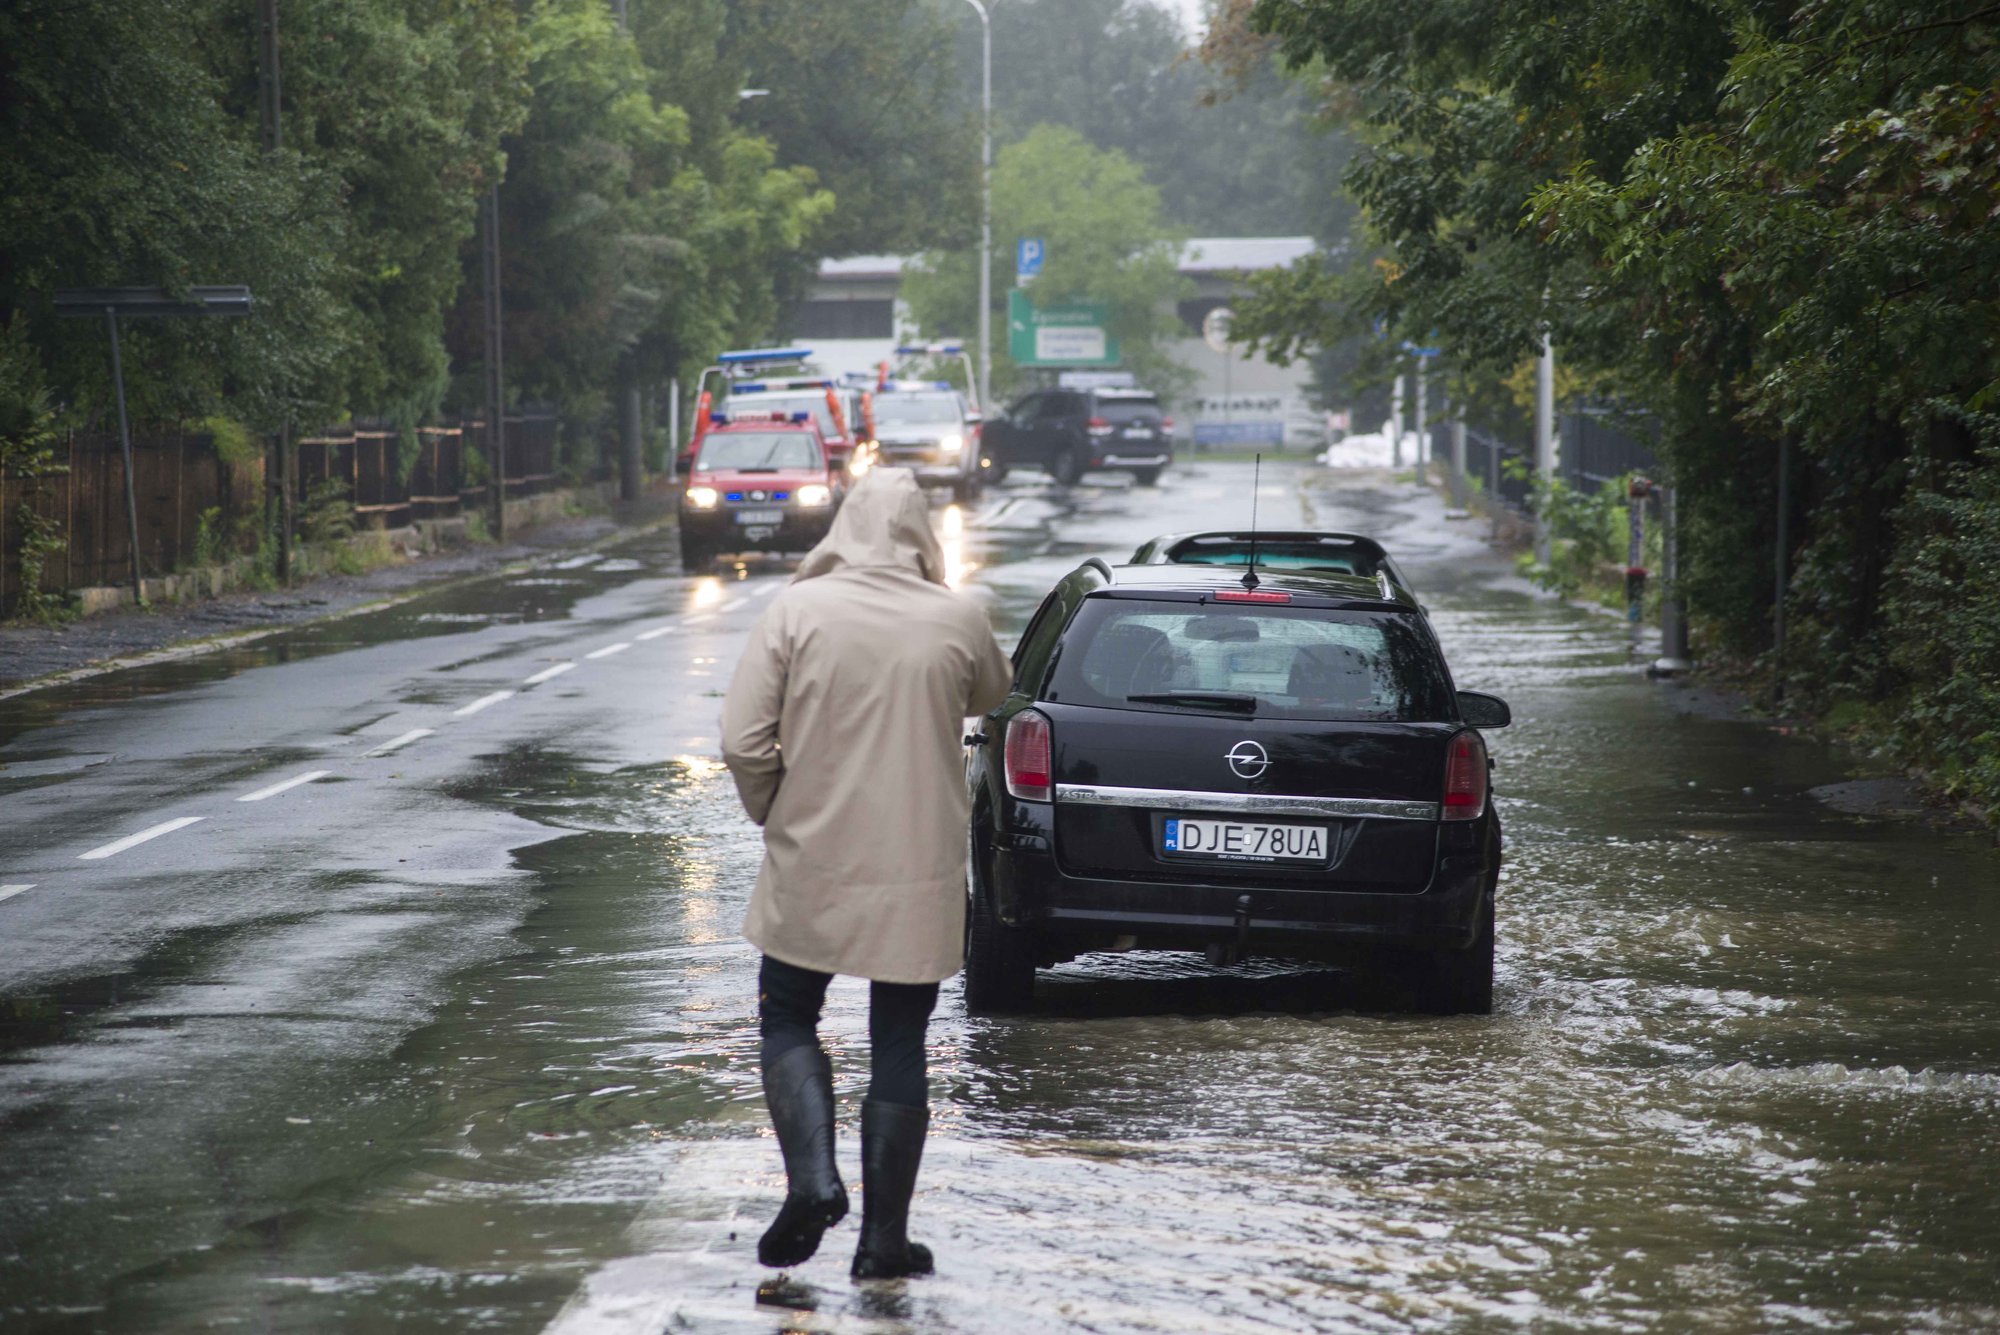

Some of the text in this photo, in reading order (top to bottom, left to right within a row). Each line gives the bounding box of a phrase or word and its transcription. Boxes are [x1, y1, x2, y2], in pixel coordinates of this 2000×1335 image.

[1023, 240, 1039, 264] P
[1062, 791, 1100, 801] ASTRA
[1166, 839, 1177, 848] PL
